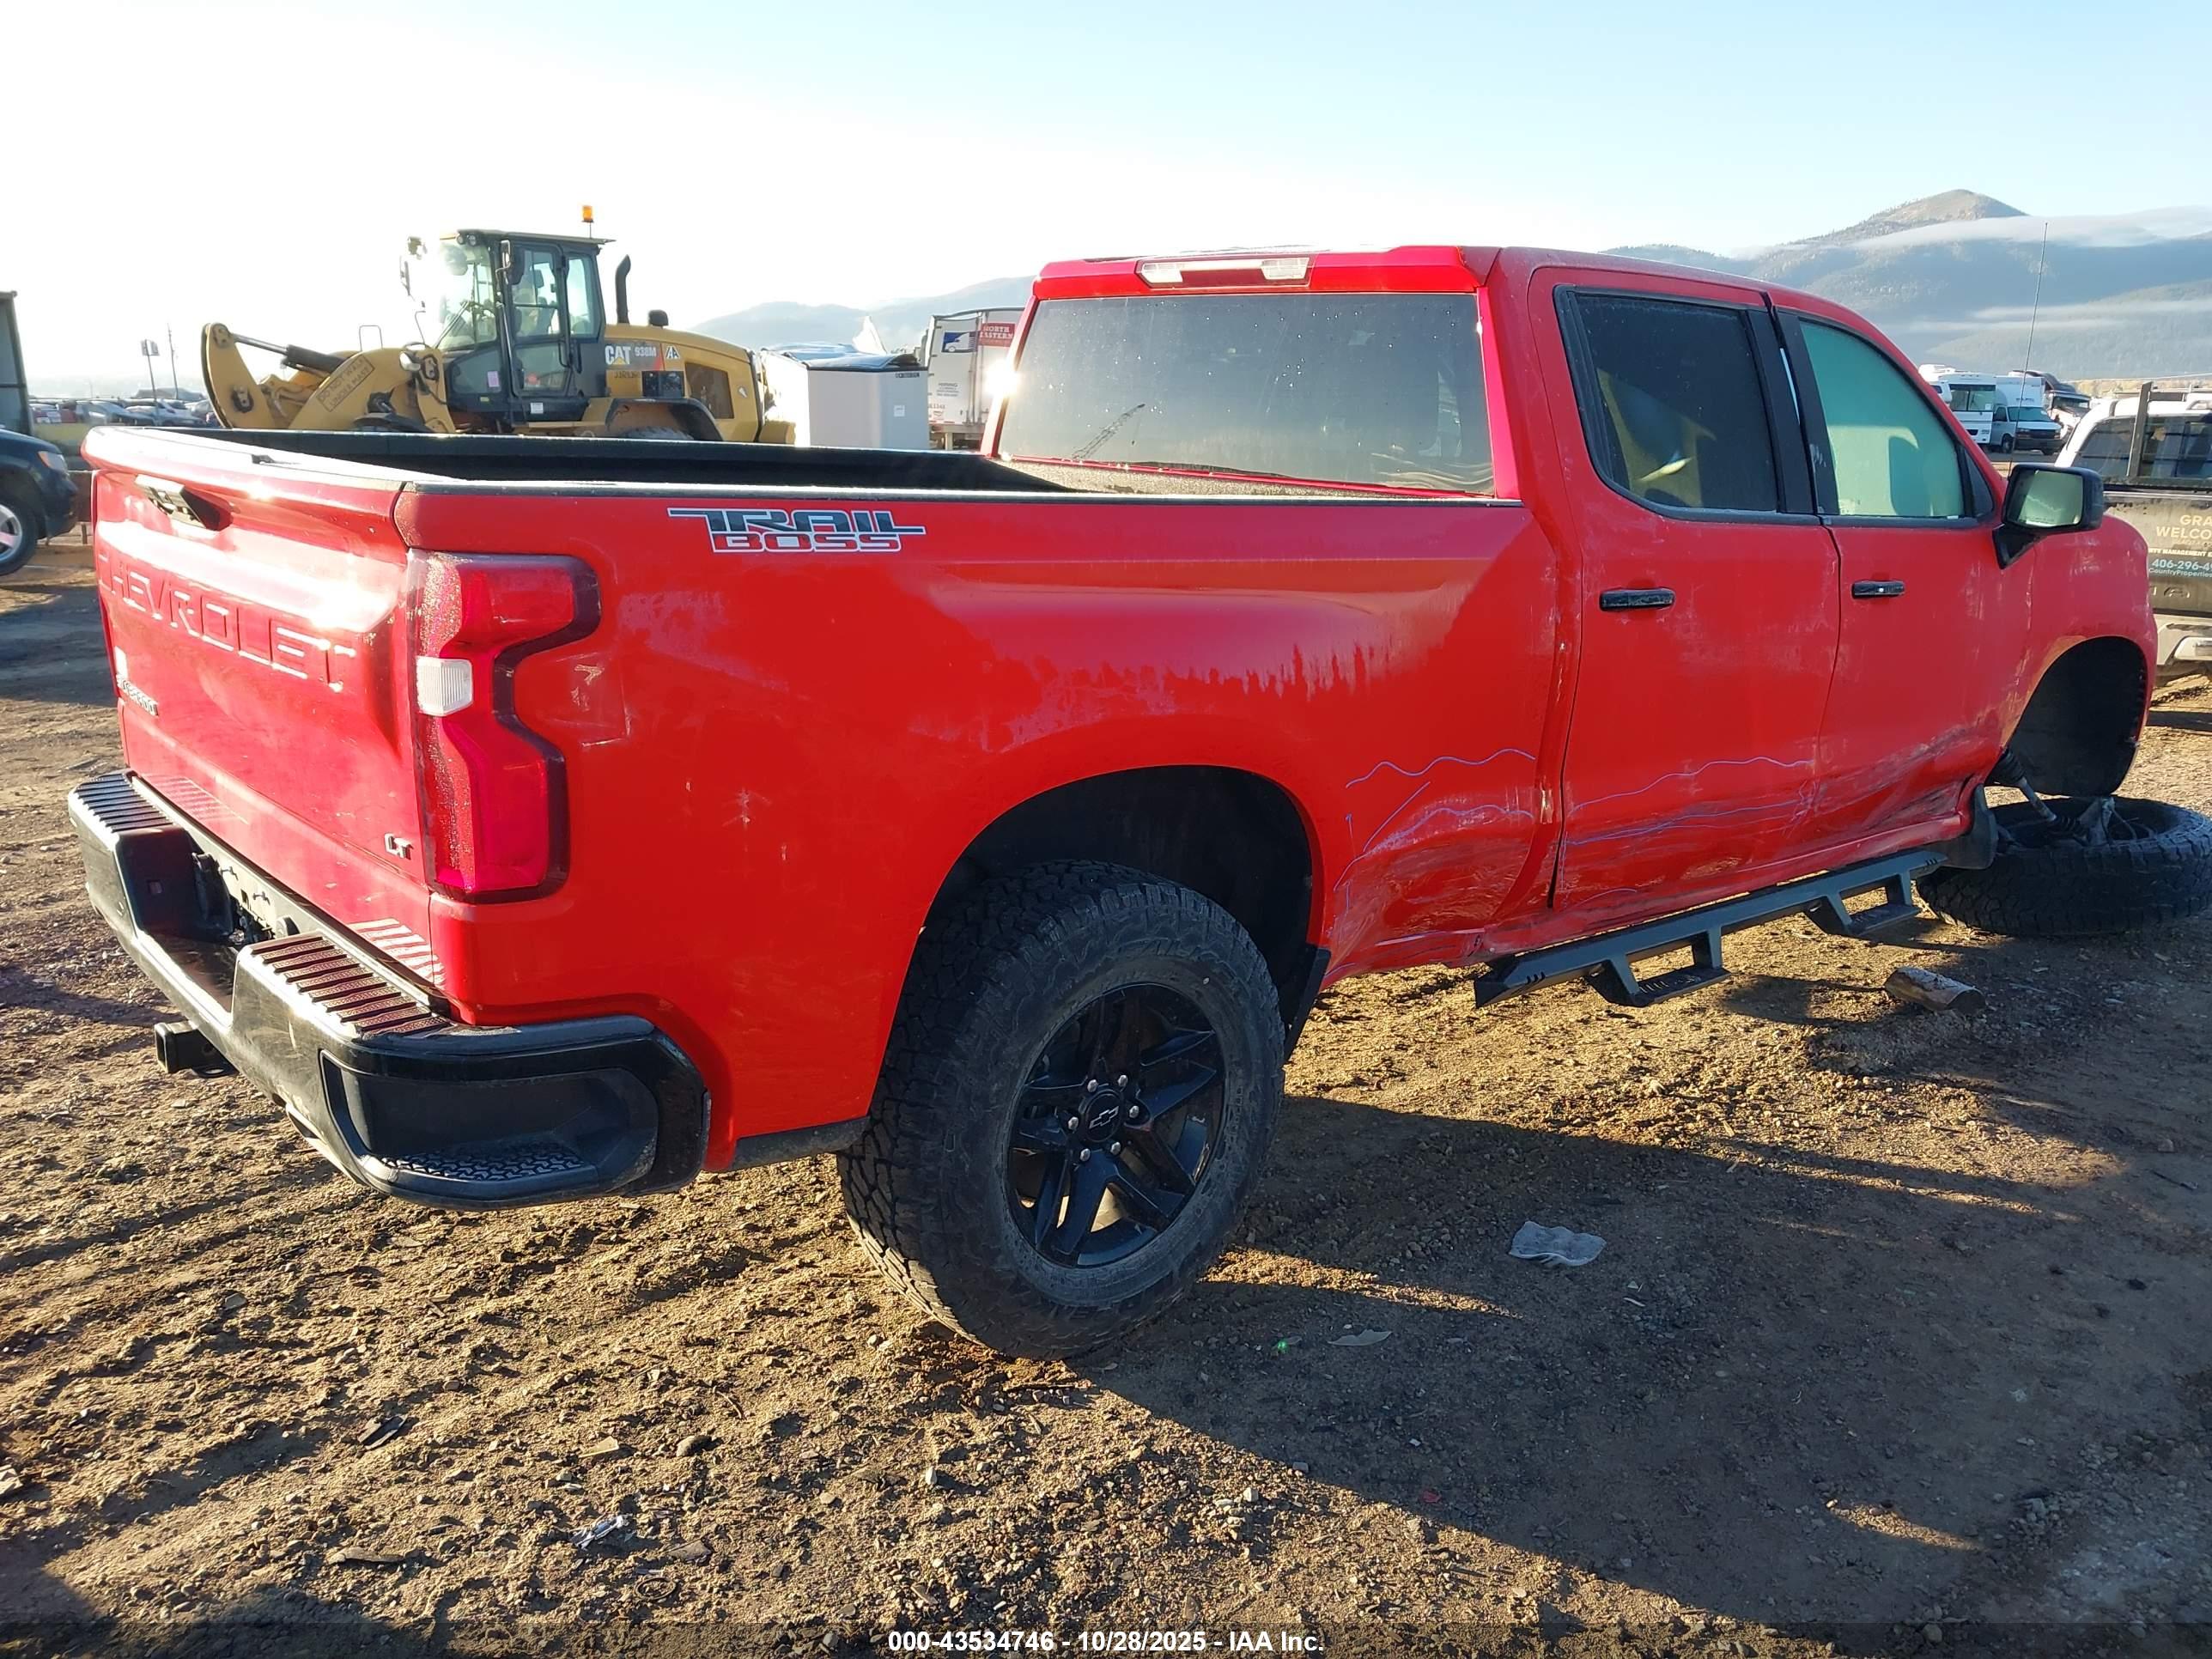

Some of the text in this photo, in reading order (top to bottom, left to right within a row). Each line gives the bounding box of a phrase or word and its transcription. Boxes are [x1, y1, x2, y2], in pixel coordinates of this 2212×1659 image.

[605, 345, 632, 365] CAT
[667, 508, 927, 535] TRAIL
[711, 532, 902, 552] BOSS
[2162, 549, 2207, 557] MANAGEMENT
[98, 554, 356, 693] CHEVROLET
[384, 832, 414, 860] LT
